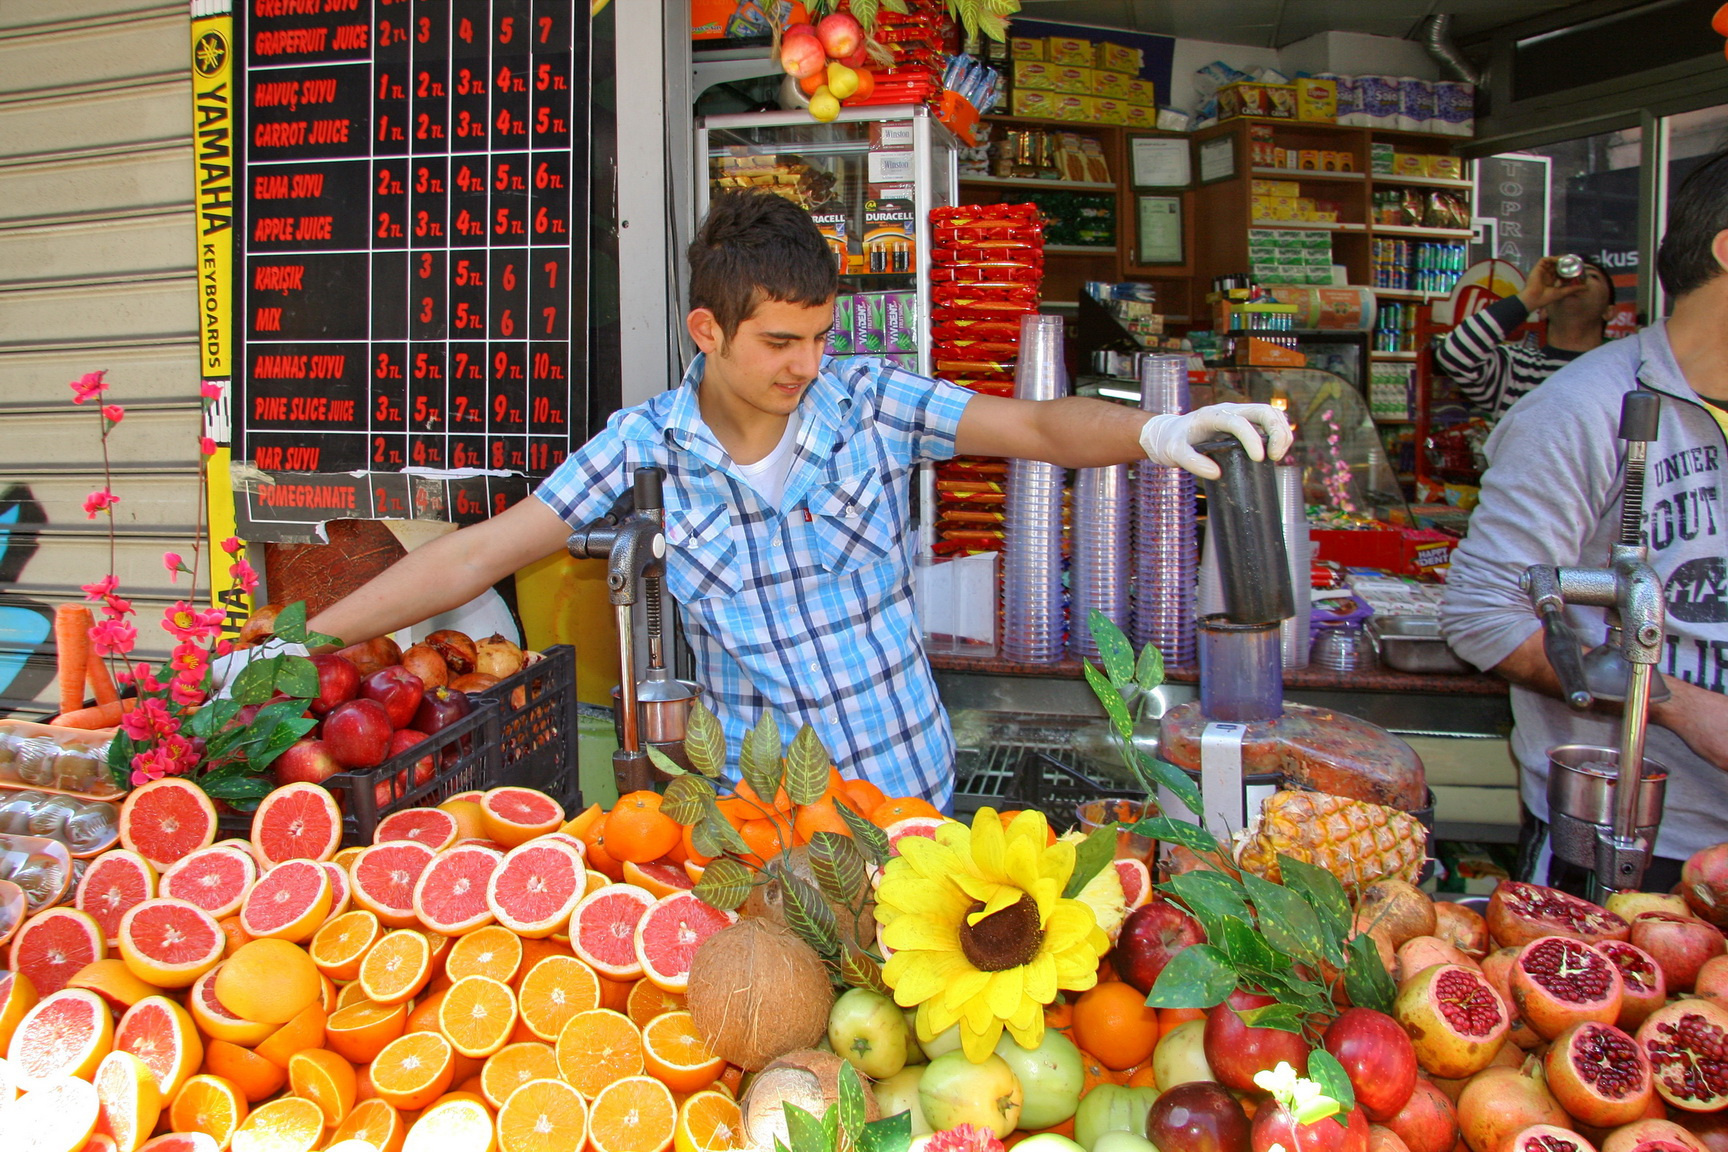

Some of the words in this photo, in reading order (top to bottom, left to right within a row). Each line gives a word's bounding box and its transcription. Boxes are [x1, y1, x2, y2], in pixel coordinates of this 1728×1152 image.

[255, 28, 328, 55] GRAPEFRUIT
[332, 25, 368, 50] JUICE
[418, 17, 431, 44] 3
[459, 18, 474, 44] 4
[499, 17, 514, 44] 5
[539, 17, 553, 44] 7
[255, 81, 299, 111] HAVUÇ
[300, 79, 336, 104] SUYU
[255, 121, 307, 147] CARROT
[308, 119, 350, 144] JUICE
[885, 129, 910, 138] Winston
[197, 82, 233, 236] YAMAHA
[884, 160, 909, 169] Winston
[255, 175, 289, 199] ELMA
[290, 174, 324, 198] SUYU
[254, 217, 294, 241] APPLE
[295, 216, 333, 240] JUICE
[812, 214, 845, 223] RACELL
[865, 212, 914, 221] DURACELL
[254, 265, 304, 297] KARIŞIK
[419, 253, 433, 279] 3
[503, 264, 516, 291] 6
[545, 262, 558, 289] 7
[203, 244, 221, 368] KEYBOARDS
[255, 307, 283, 332] MIX
[420, 297, 434, 323] 3
[501, 310, 515, 336] 6
[543, 307, 557, 333] 7
[254, 355, 308, 379] ANANAS
[309, 355, 345, 379] SUYU
[255, 397, 288, 420] PINE
[289, 397, 327, 420] SLICE
[328, 400, 354, 421] JUICE
[255, 447, 283, 471] NAR
[284, 447, 320, 470] SUYU
[1654, 445, 1719, 487] UNIER
[258, 482, 357, 510] POMEGRANATE
[1418, 547, 1448, 560] HAPPY
[1419, 554, 1449, 567] DENT
